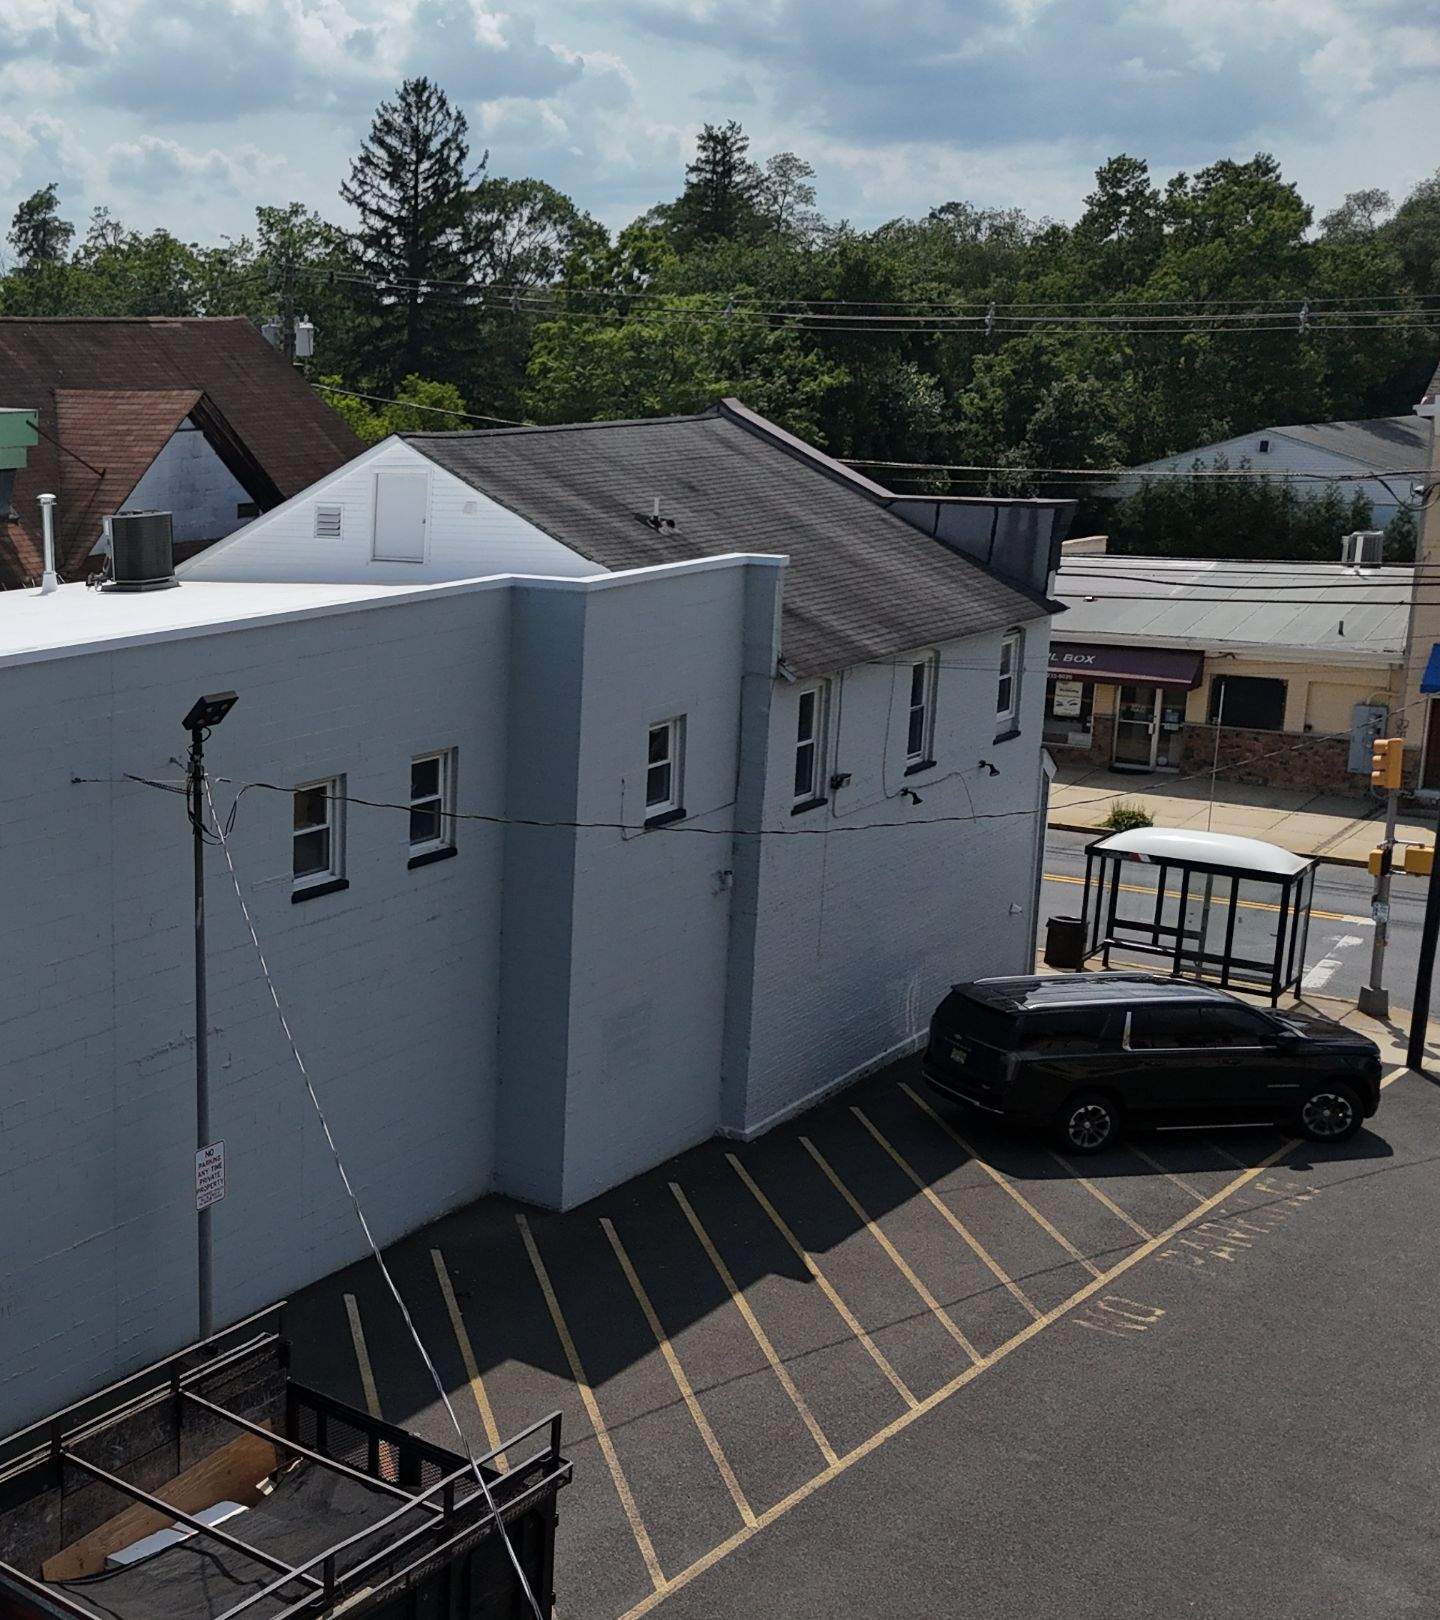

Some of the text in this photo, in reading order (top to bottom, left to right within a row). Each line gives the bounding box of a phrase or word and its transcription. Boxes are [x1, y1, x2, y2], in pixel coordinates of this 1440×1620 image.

[1063, 653, 1096, 664] BOX
[205, 1149, 214, 1158] NO
[198, 1154, 221, 1169] PARKING
[198, 1162, 222, 1178] ANY TIME
[197, 1178, 224, 1193] PROPERTY
[199, 1171, 221, 1186] PRIVATE
